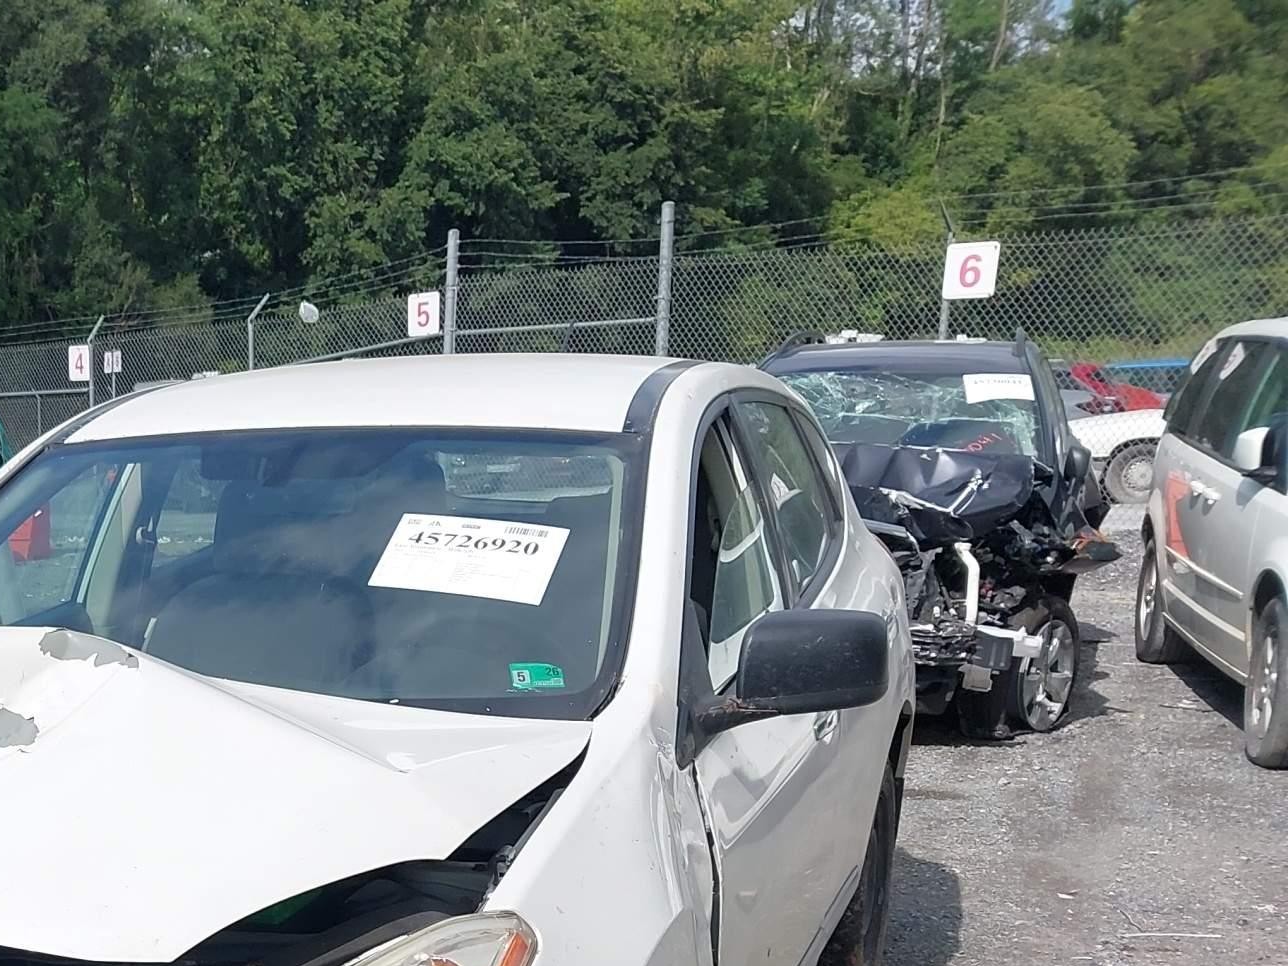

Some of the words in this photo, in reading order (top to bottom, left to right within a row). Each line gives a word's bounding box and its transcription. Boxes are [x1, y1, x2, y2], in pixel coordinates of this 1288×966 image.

[959, 254, 982, 288] 6
[417, 302, 431, 327] 5
[74, 353, 85, 375] 4
[408, 531, 540, 556] 45726920
[517, 671, 526, 682] 5
[545, 667, 560, 678] 26
